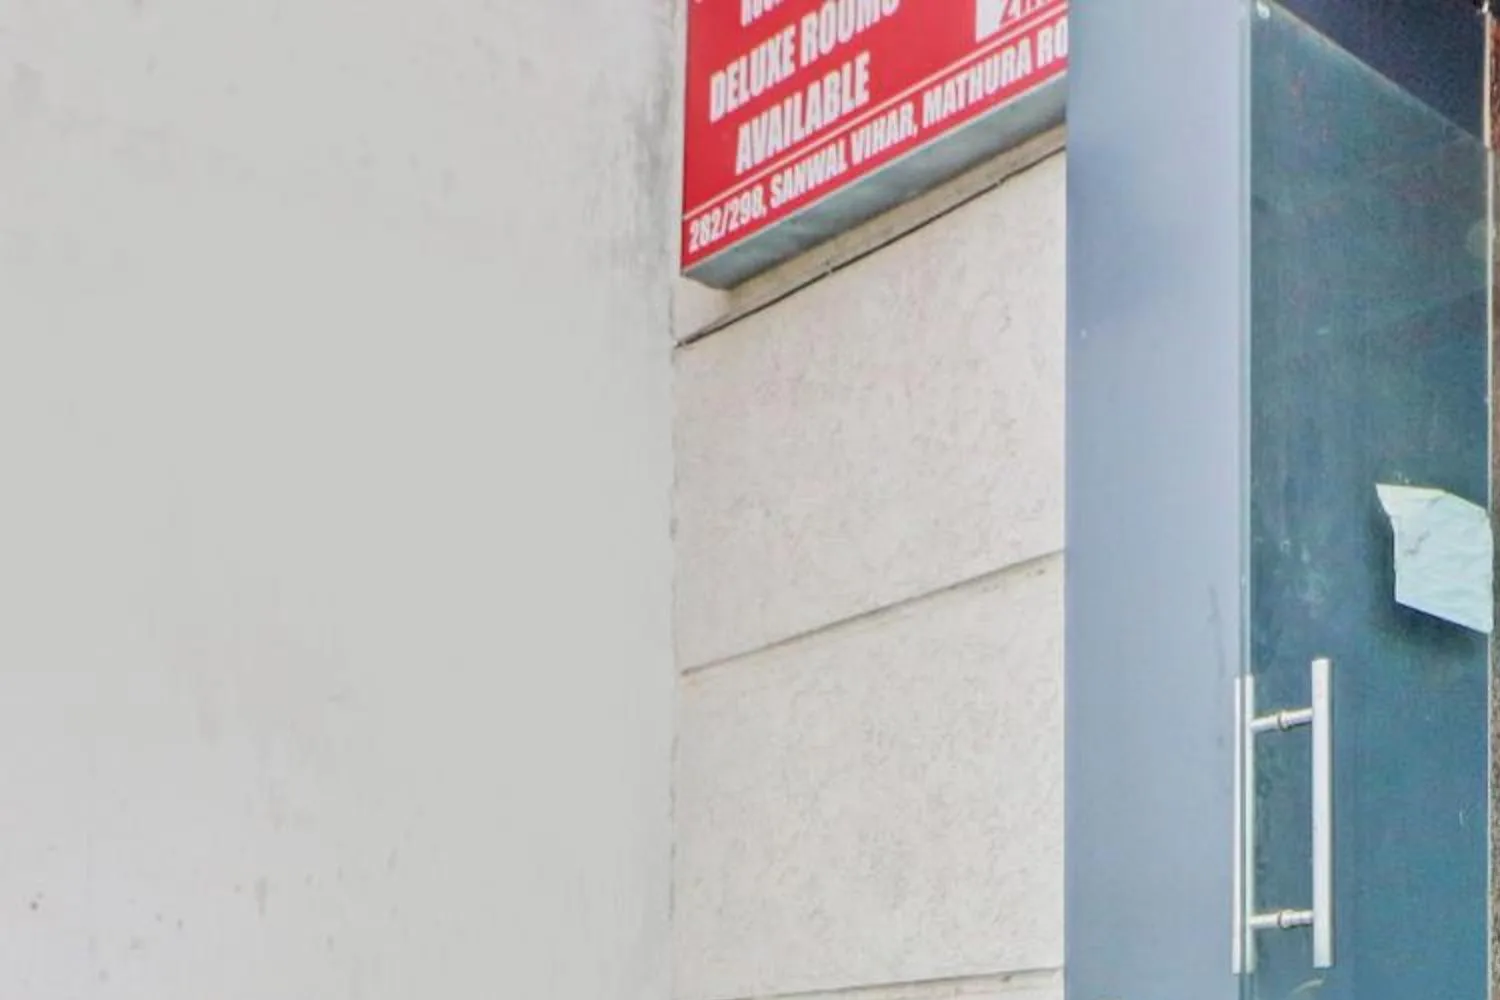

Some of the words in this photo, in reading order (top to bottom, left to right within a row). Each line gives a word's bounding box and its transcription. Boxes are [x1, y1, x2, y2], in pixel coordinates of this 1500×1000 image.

[710, 24, 797, 124] DELUXE
[735, 50, 870, 176] AVAILABLE
[770, 138, 848, 209] SANWAL
[851, 101, 918, 166] VIHAR,
[922, 35, 1033, 129] MATHURA
